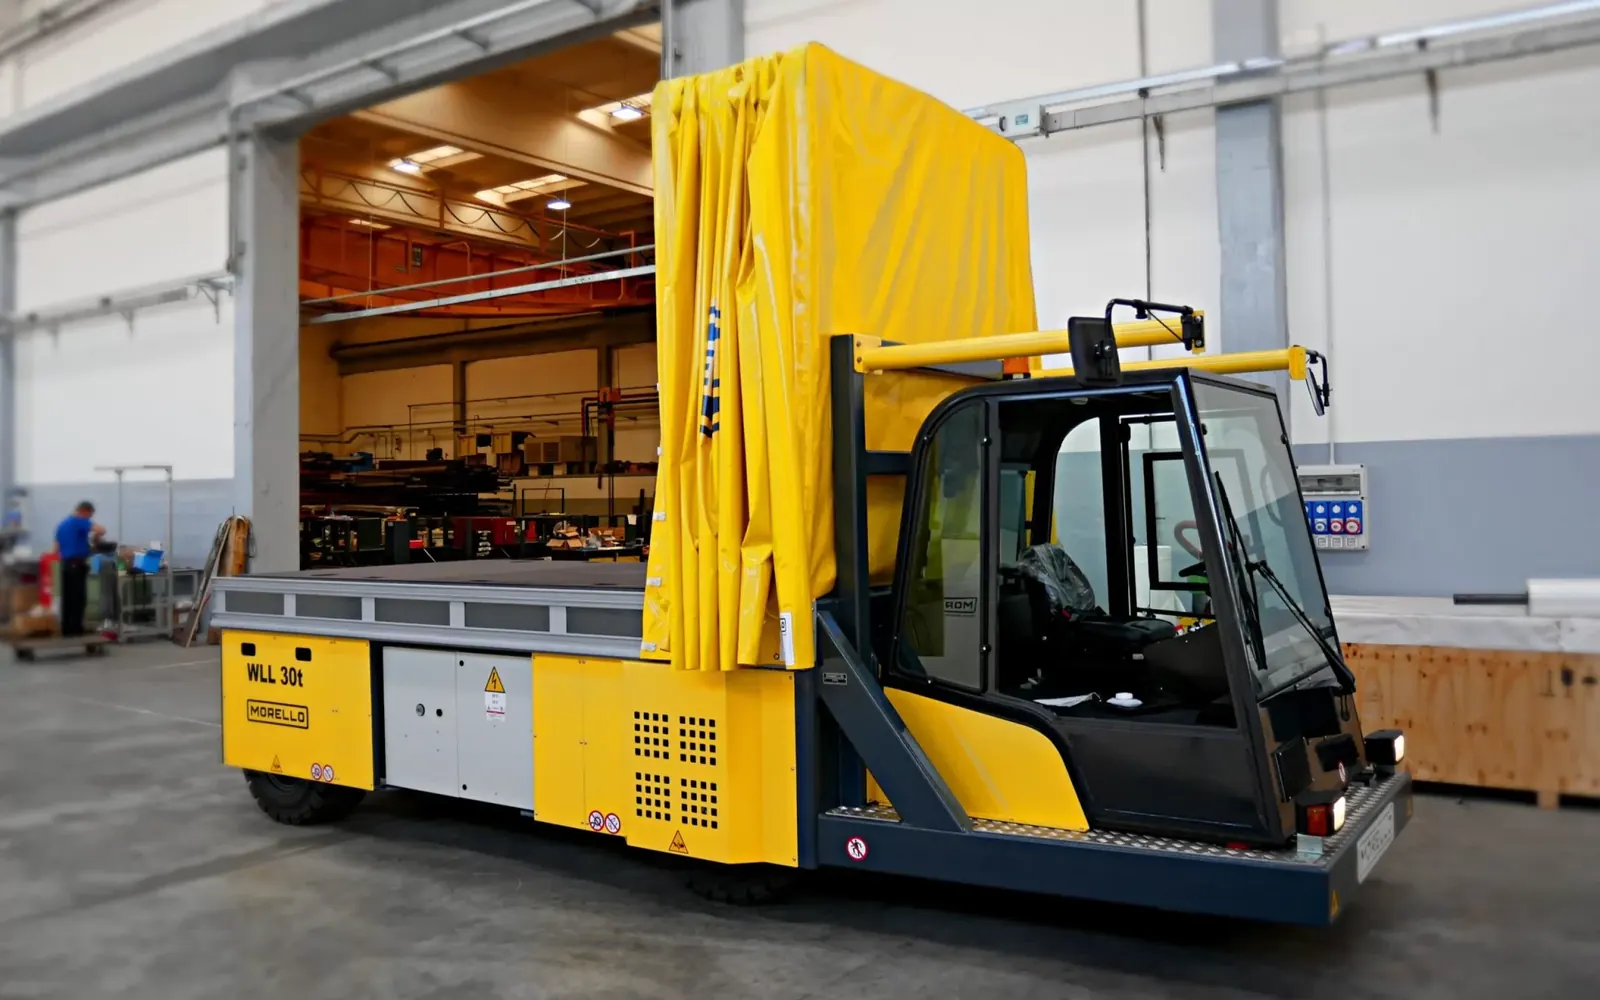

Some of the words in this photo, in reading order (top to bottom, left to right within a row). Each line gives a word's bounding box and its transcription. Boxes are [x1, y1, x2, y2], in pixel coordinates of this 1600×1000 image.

[247, 663, 276, 684] WLL
[280, 666, 303, 688] 30t
[250, 705, 305, 723] MORELLO
